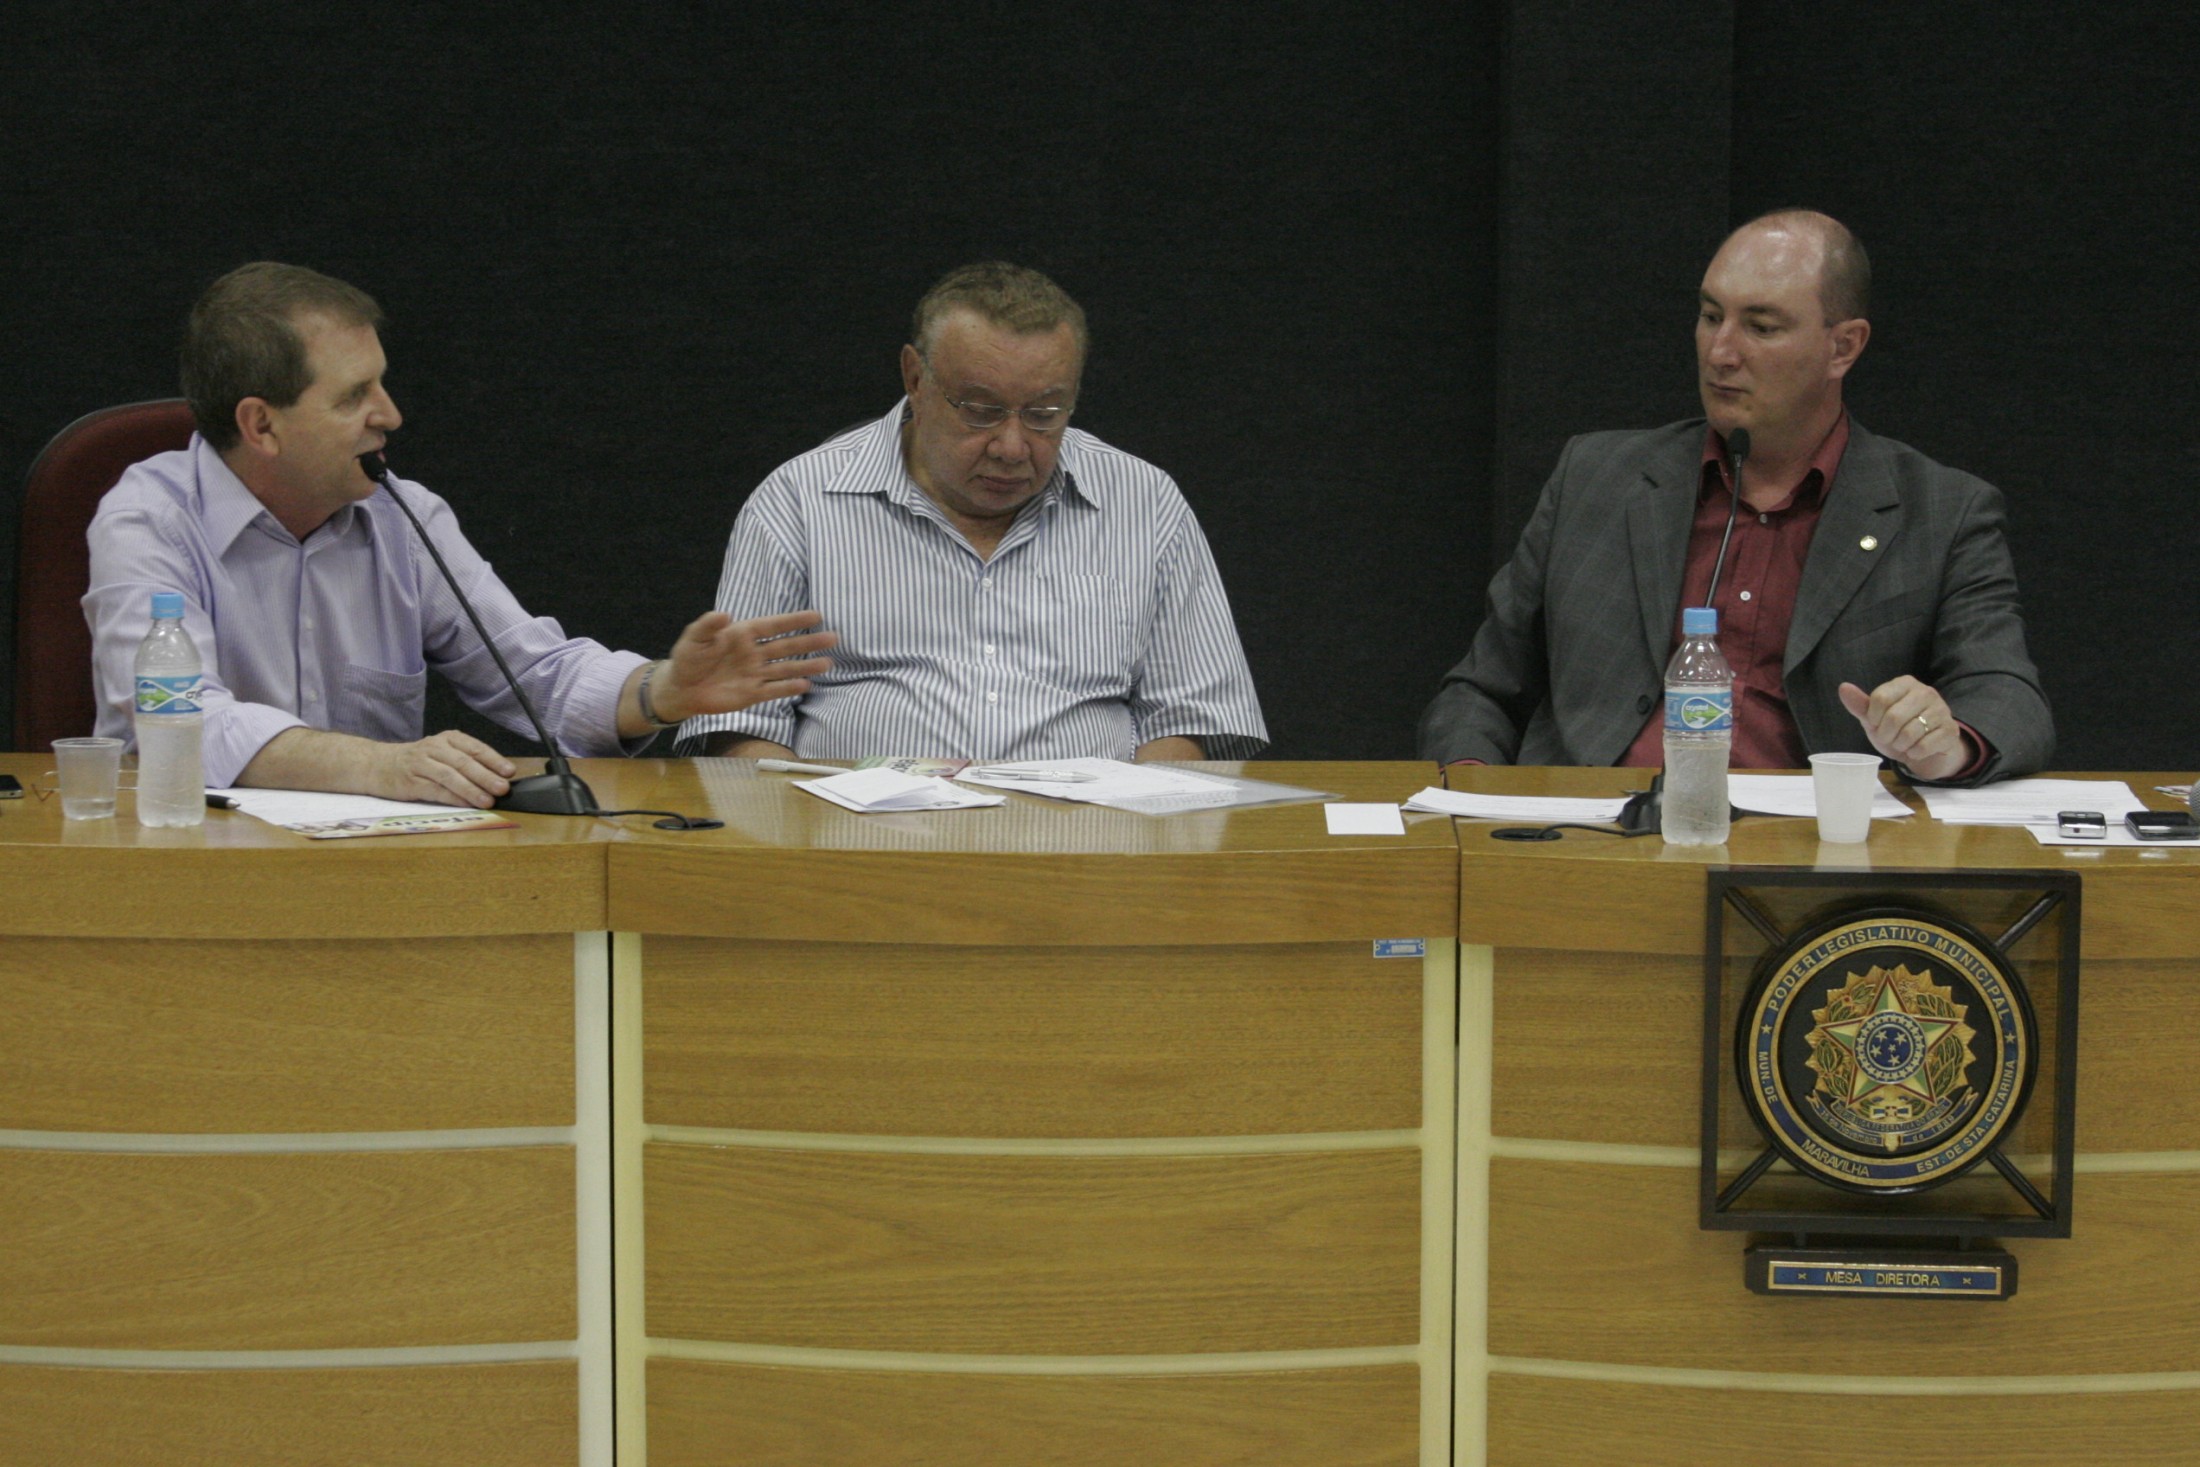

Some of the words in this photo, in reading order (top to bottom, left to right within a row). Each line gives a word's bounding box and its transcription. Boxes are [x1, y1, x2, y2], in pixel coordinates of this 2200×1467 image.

[1768, 956, 1816, 1012] PODER
[1816, 927, 1929, 960] LEGISLATIVO
[1936, 938, 2010, 1019] MUNICIPAL
[1764, 1086, 1778, 1104] DE
[1801, 1139, 1870, 1177] MARAVILHA
[1916, 1158, 1945, 1173] EST.
[1946, 1145, 1964, 1160] DE
[1963, 1124, 1989, 1148] STA.
[1985, 1060, 2016, 1124] CATARINA
[1825, 1271, 1863, 1284] MESA
[1876, 1273, 1940, 1287] DIRETORA
